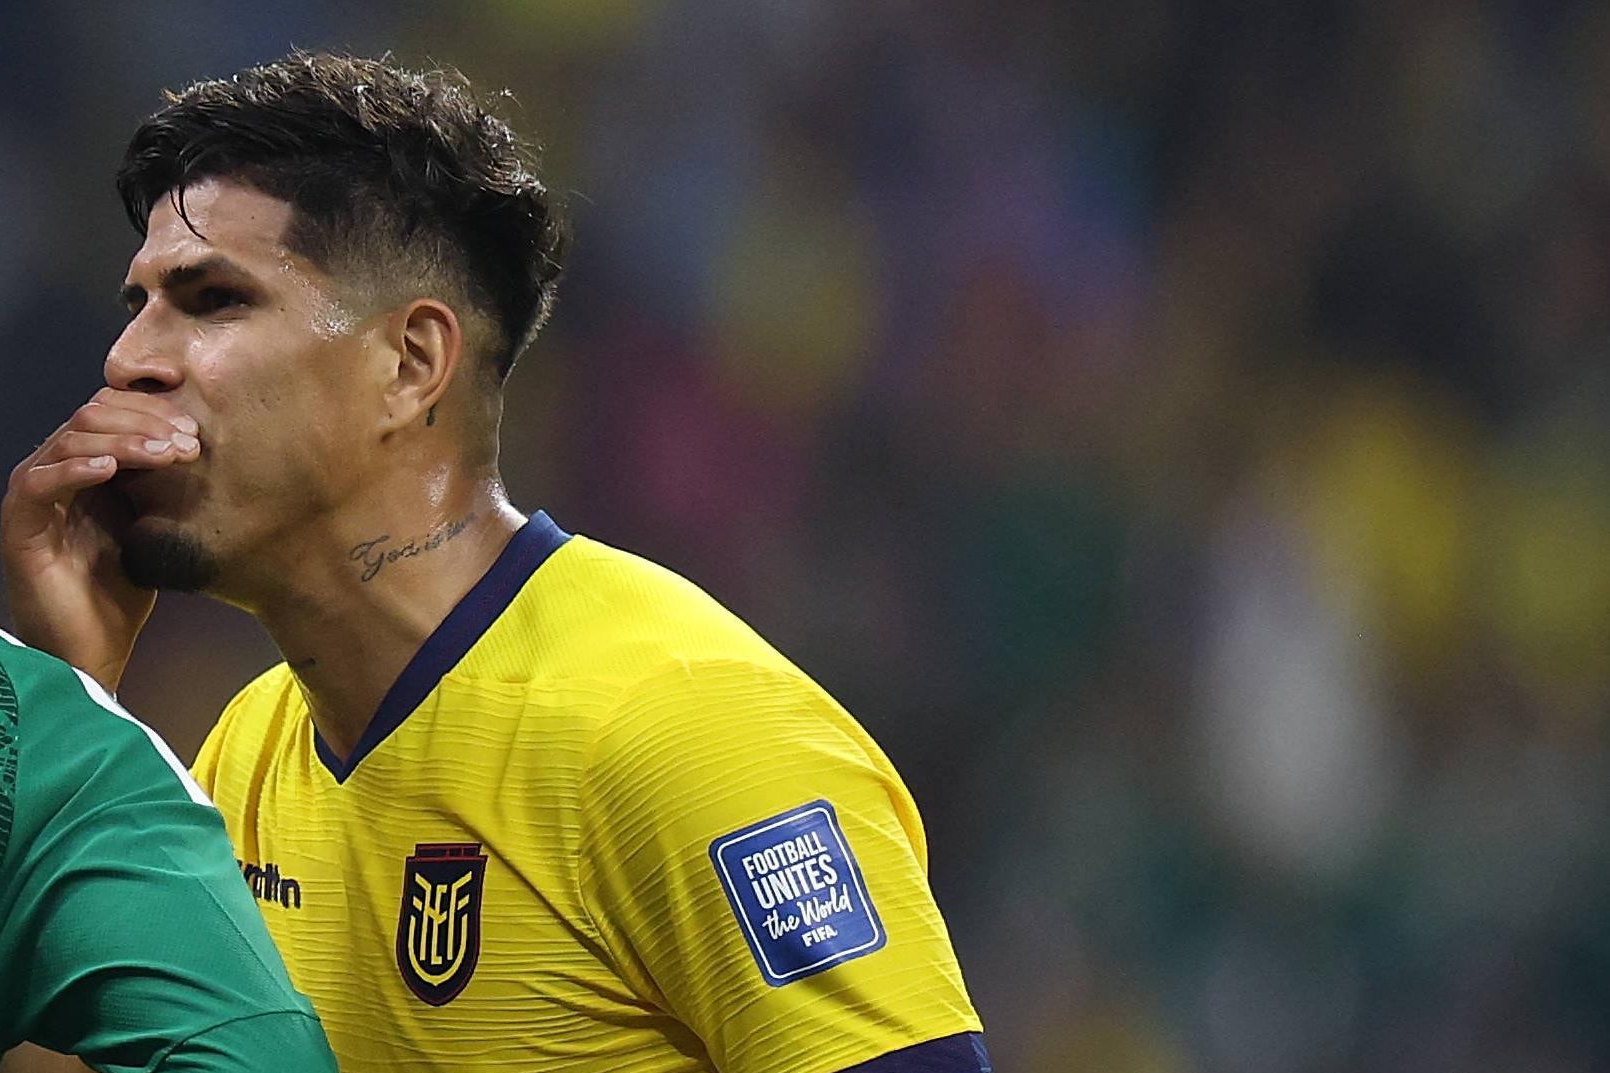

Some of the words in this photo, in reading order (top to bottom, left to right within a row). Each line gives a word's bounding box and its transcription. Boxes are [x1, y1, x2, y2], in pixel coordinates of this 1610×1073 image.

[742, 831, 827, 879] FOOTBALL
[751, 854, 838, 910] UNITES
[762, 909, 800, 940] the
[797, 883, 853, 926] World
[801, 924, 838, 948] FIFA
